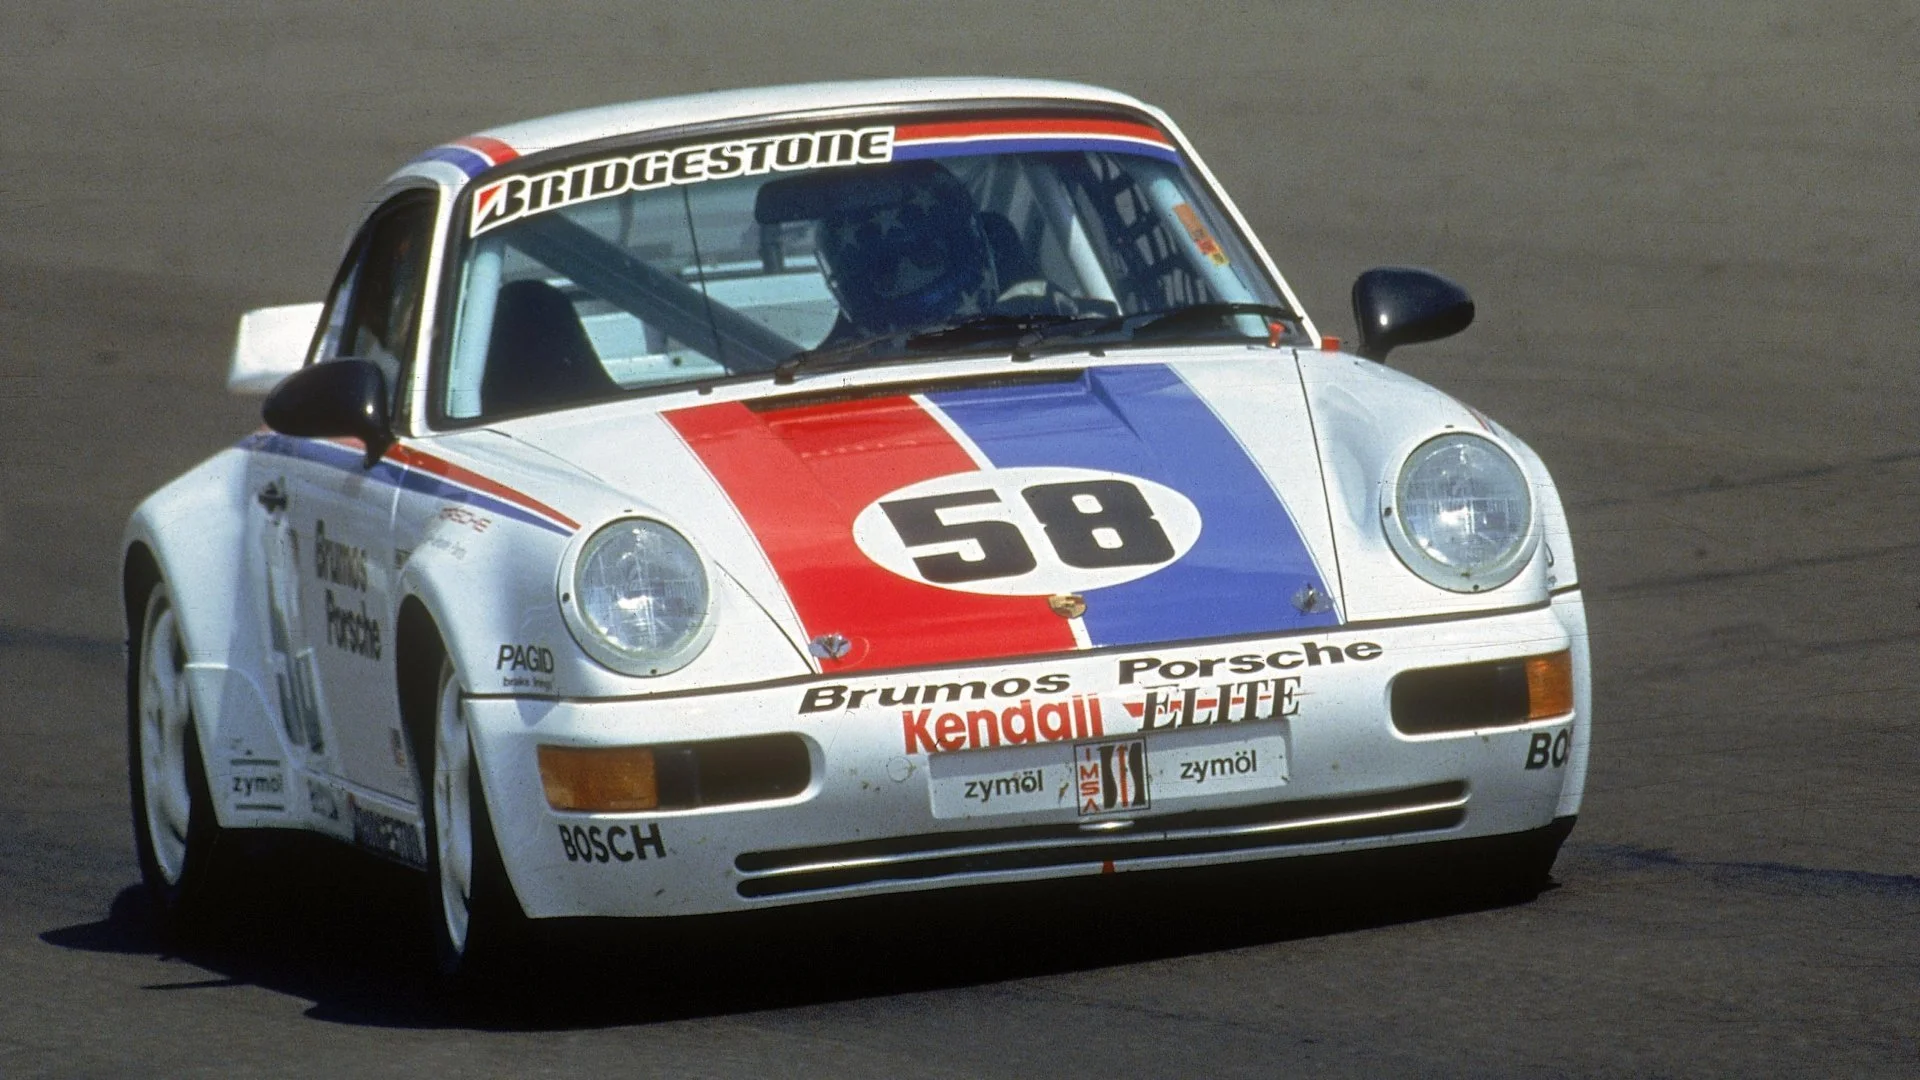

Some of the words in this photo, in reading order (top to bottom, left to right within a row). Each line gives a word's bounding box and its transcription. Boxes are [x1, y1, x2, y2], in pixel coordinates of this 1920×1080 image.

[473, 129, 893, 235] BRIDGESTONE
[878, 479, 1176, 585] 58
[497, 644, 554, 673] PAGID
[799, 673, 1071, 714] Brumos
[1118, 641, 1383, 685] Porsche
[902, 693, 1104, 755] Kendall
[1138, 676, 1301, 732] ELITE
[964, 769, 1044, 803] zymöl
[1180, 750, 1257, 783] zymöl
[558, 823, 667, 863] BOSCH
